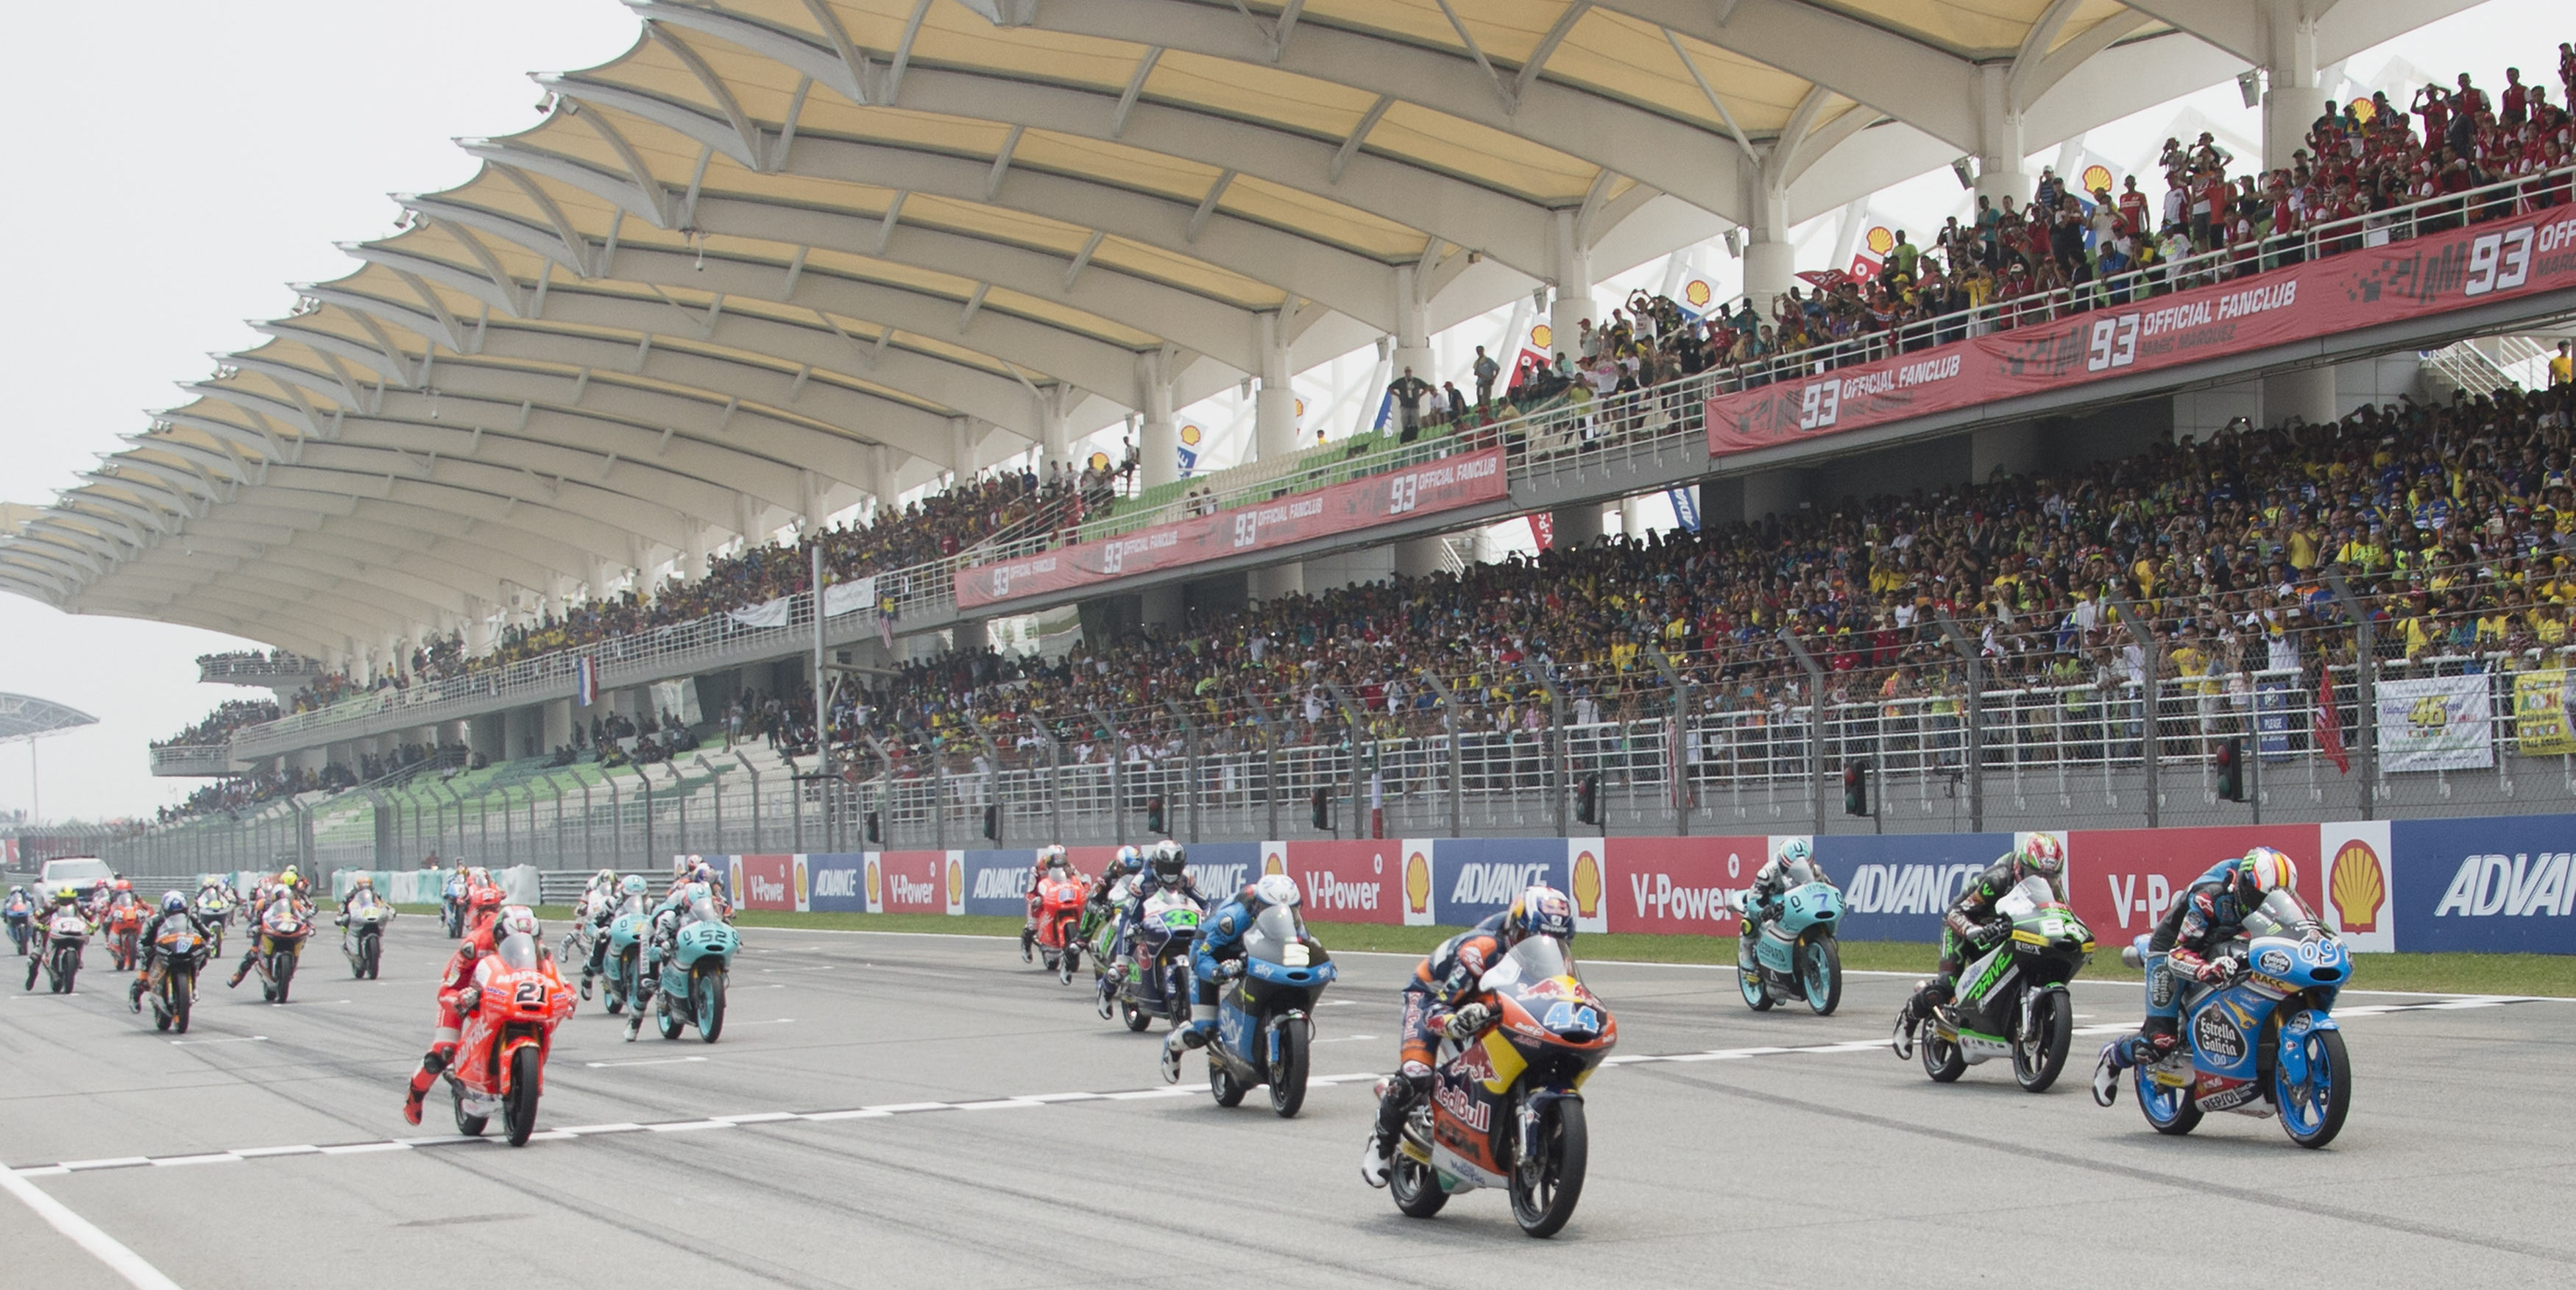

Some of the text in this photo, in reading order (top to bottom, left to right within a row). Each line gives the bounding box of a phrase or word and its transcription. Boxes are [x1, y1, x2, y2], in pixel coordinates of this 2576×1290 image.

[2465, 225, 2535, 296] 93
[2088, 313, 2140, 372] 93
[2142, 300, 2212, 336] OFFICIAL
[2217, 280, 2297, 321] FANCLUB
[1801, 378, 1840, 430] 93
[1843, 369, 1894, 400] OFFICIAL
[1898, 354, 1961, 388] FANCLUB
[1390, 473, 1417, 514] 93
[1418, 467, 1454, 490] OFFICIAL
[1457, 457, 1496, 482] FANCLUB
[1234, 511, 1256, 547] 93
[1258, 506, 1287, 526] OFFICIAL
[1290, 497, 1323, 520] FANCLUB
[1105, 542, 1123, 574] 93
[994, 566, 1009, 597] 93
[2407, 694, 2450, 729] 46
[750, 875, 785, 902] V-Power
[815, 868, 857, 896] ADVANCE
[889, 874, 934, 904] V-Power
[972, 867, 1028, 899] ADVANCE
[1306, 871, 1381, 910] V-Power
[1812, 893, 1828, 910] 7
[1165, 910, 1198, 927] 33
[700, 929, 727, 943] 52
[2299, 938, 2339, 967] 09
[1254, 963, 1274, 978] sky
[1968, 952, 2013, 1000] DRIVE
[2254, 971, 2285, 988] RACC
[516, 982, 546, 1003] 21
[1544, 1001, 1599, 1034] 44
[2201, 1017, 2236, 1041] Estrella
[2202, 1033, 2237, 1056] Galicia
[2202, 1091, 2238, 1110] REPSOL
